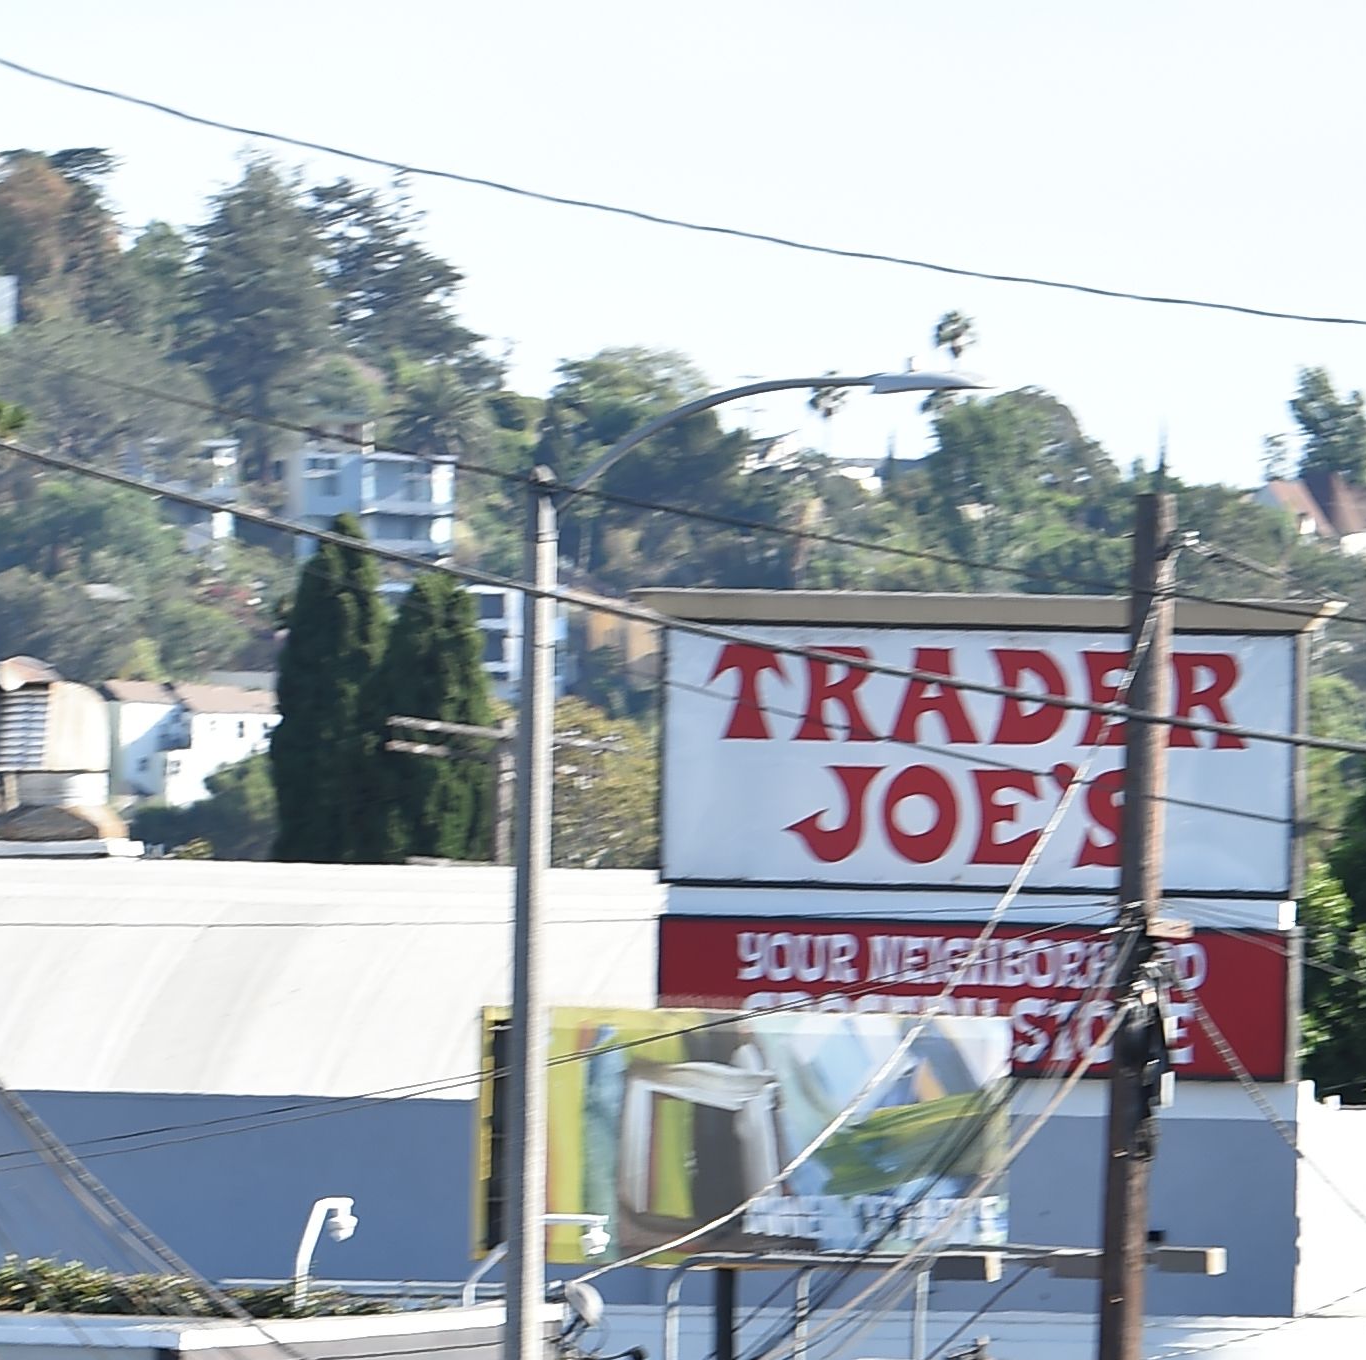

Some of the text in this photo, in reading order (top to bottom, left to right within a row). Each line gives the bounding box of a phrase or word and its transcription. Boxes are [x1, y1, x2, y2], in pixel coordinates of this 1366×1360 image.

[708, 643, 1249, 750] TRADER
[782, 762, 1127, 866] JOE'S
[737, 931, 859, 984] YOUR
